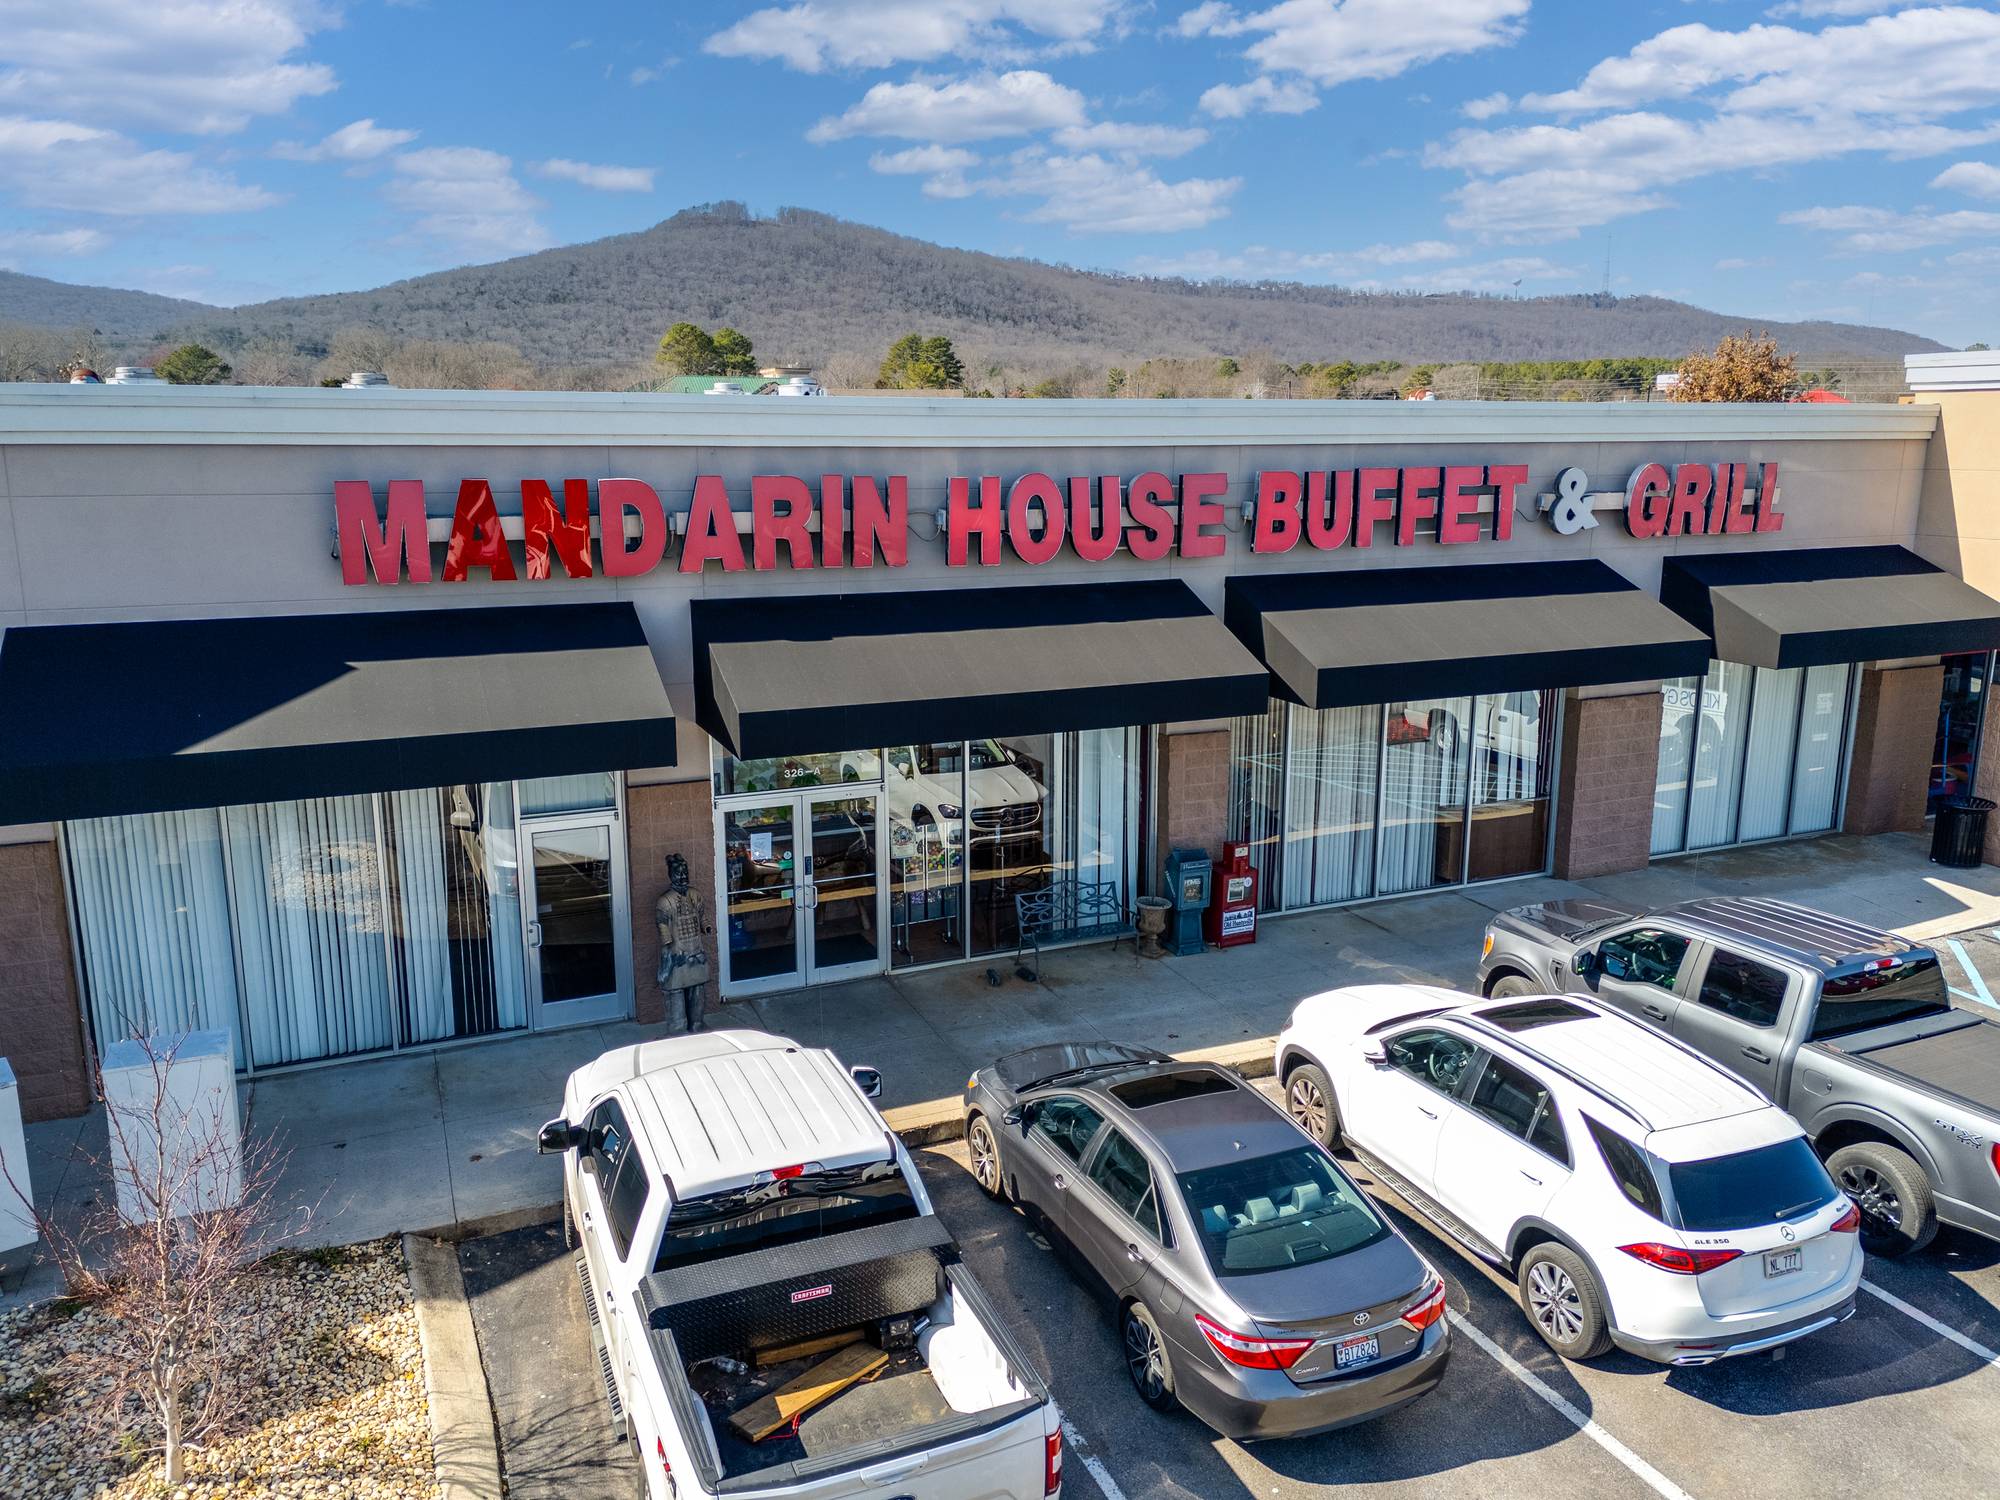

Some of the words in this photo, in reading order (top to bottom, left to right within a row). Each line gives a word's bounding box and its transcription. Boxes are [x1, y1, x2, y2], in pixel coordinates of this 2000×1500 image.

[334, 475, 909, 586] MANDARIN
[945, 472, 1228, 567] HOUSE
[1250, 464, 1529, 554] BUFFET
[1548, 466, 1599, 536] &
[1624, 462, 1784, 539] GRILL
[784, 766, 821, 778] 326-A
[1770, 1258, 1780, 1272] NL
[1784, 1253, 1797, 1268] 777
[794, 1287, 830, 1300] CRAFTSMAN
